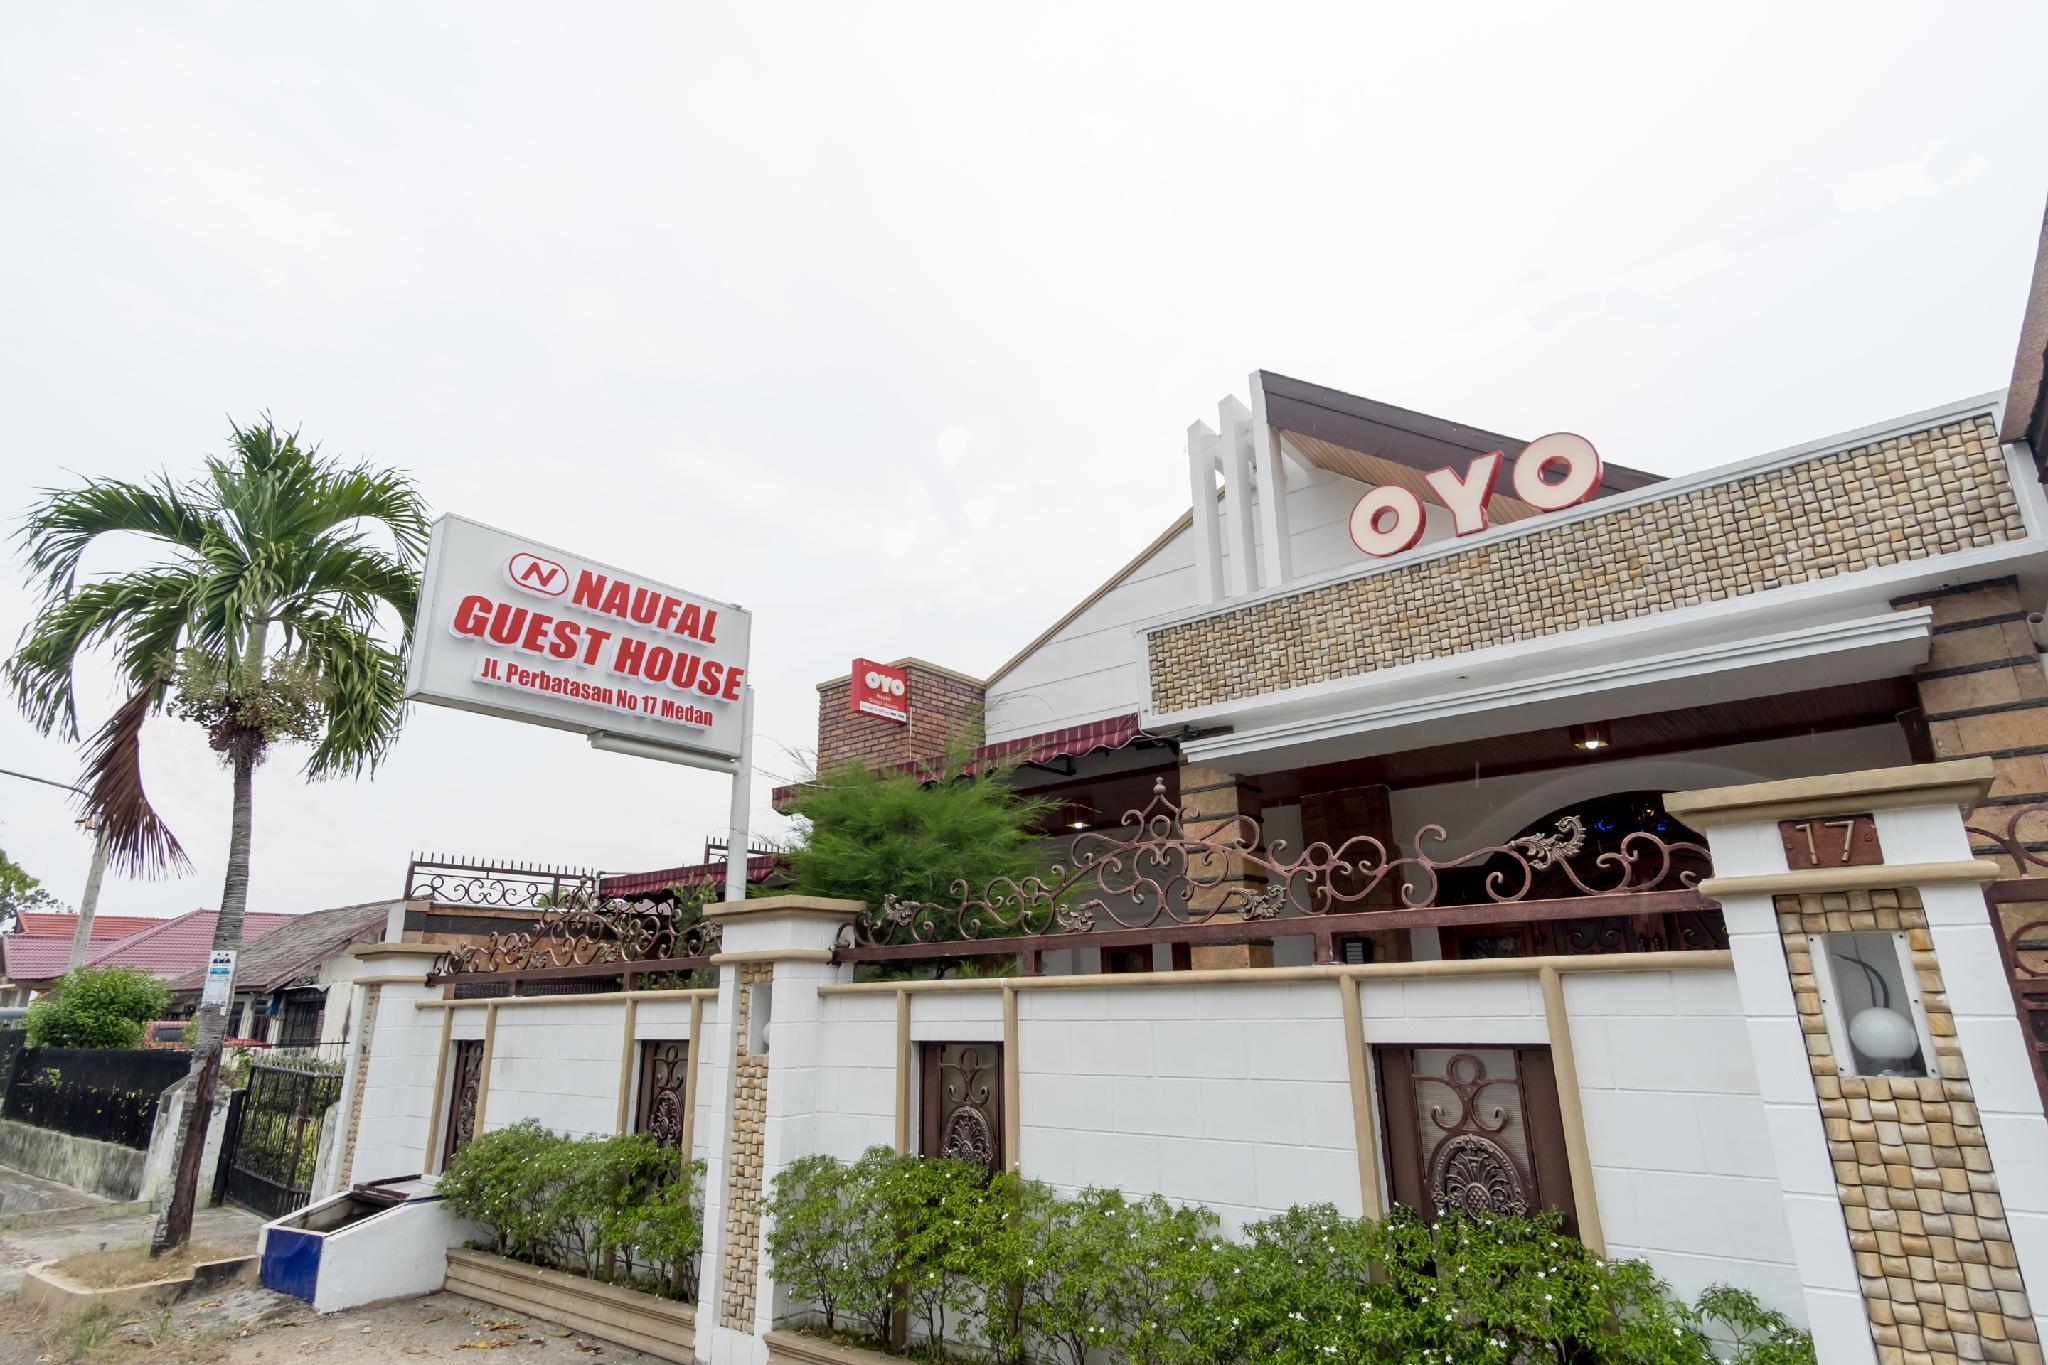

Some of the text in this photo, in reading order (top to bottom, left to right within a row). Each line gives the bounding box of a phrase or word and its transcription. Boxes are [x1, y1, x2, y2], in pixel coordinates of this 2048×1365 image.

[1349, 431, 1603, 557] OYO
[571, 569, 718, 644] NAUFAL
[453, 595, 745, 701] GUEST HOUSE
[506, 662, 613, 704] Perbatasan
[617, 689, 637, 711] No
[642, 695, 657, 715] 17
[661, 699, 713, 727] Medan
[865, 671, 905, 696] OYO
[1796, 820, 1854, 865] 17
